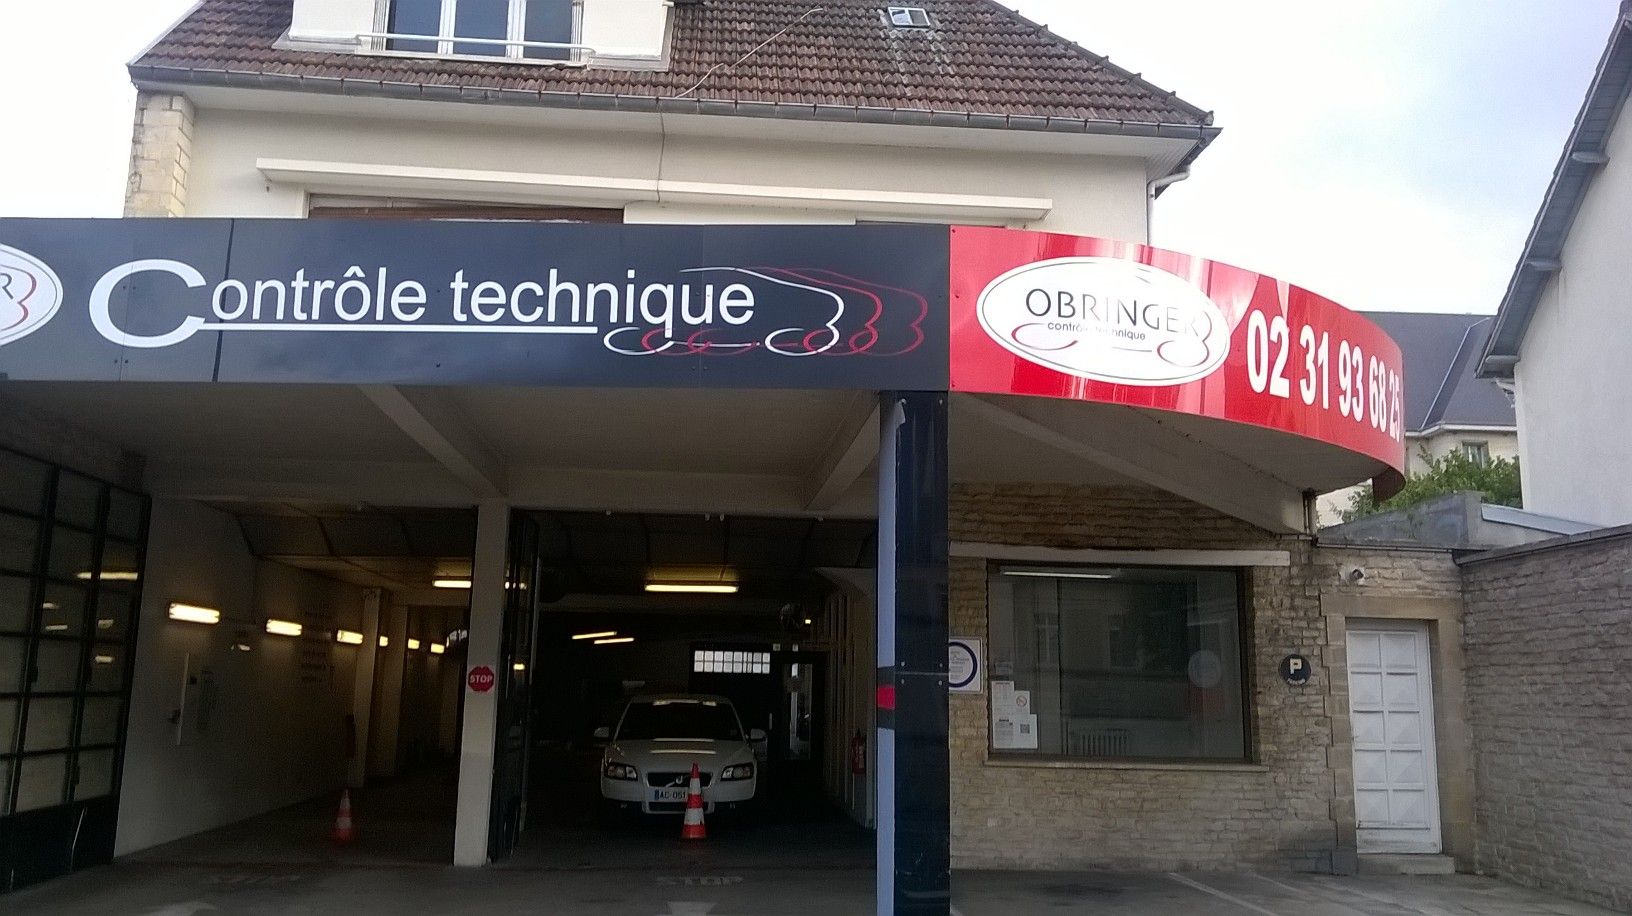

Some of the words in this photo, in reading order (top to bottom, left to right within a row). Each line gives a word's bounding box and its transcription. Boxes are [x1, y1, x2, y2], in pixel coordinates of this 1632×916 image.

[89, 258, 427, 348] Contrôle
[450, 268, 755, 338] technique
[1247, 309, 1290, 399] 02
[1300, 325, 1329, 410] 31
[1338, 340, 1364, 423] 93
[1369, 355, 1387, 433] 68
[469, 674, 493, 684] STOP
